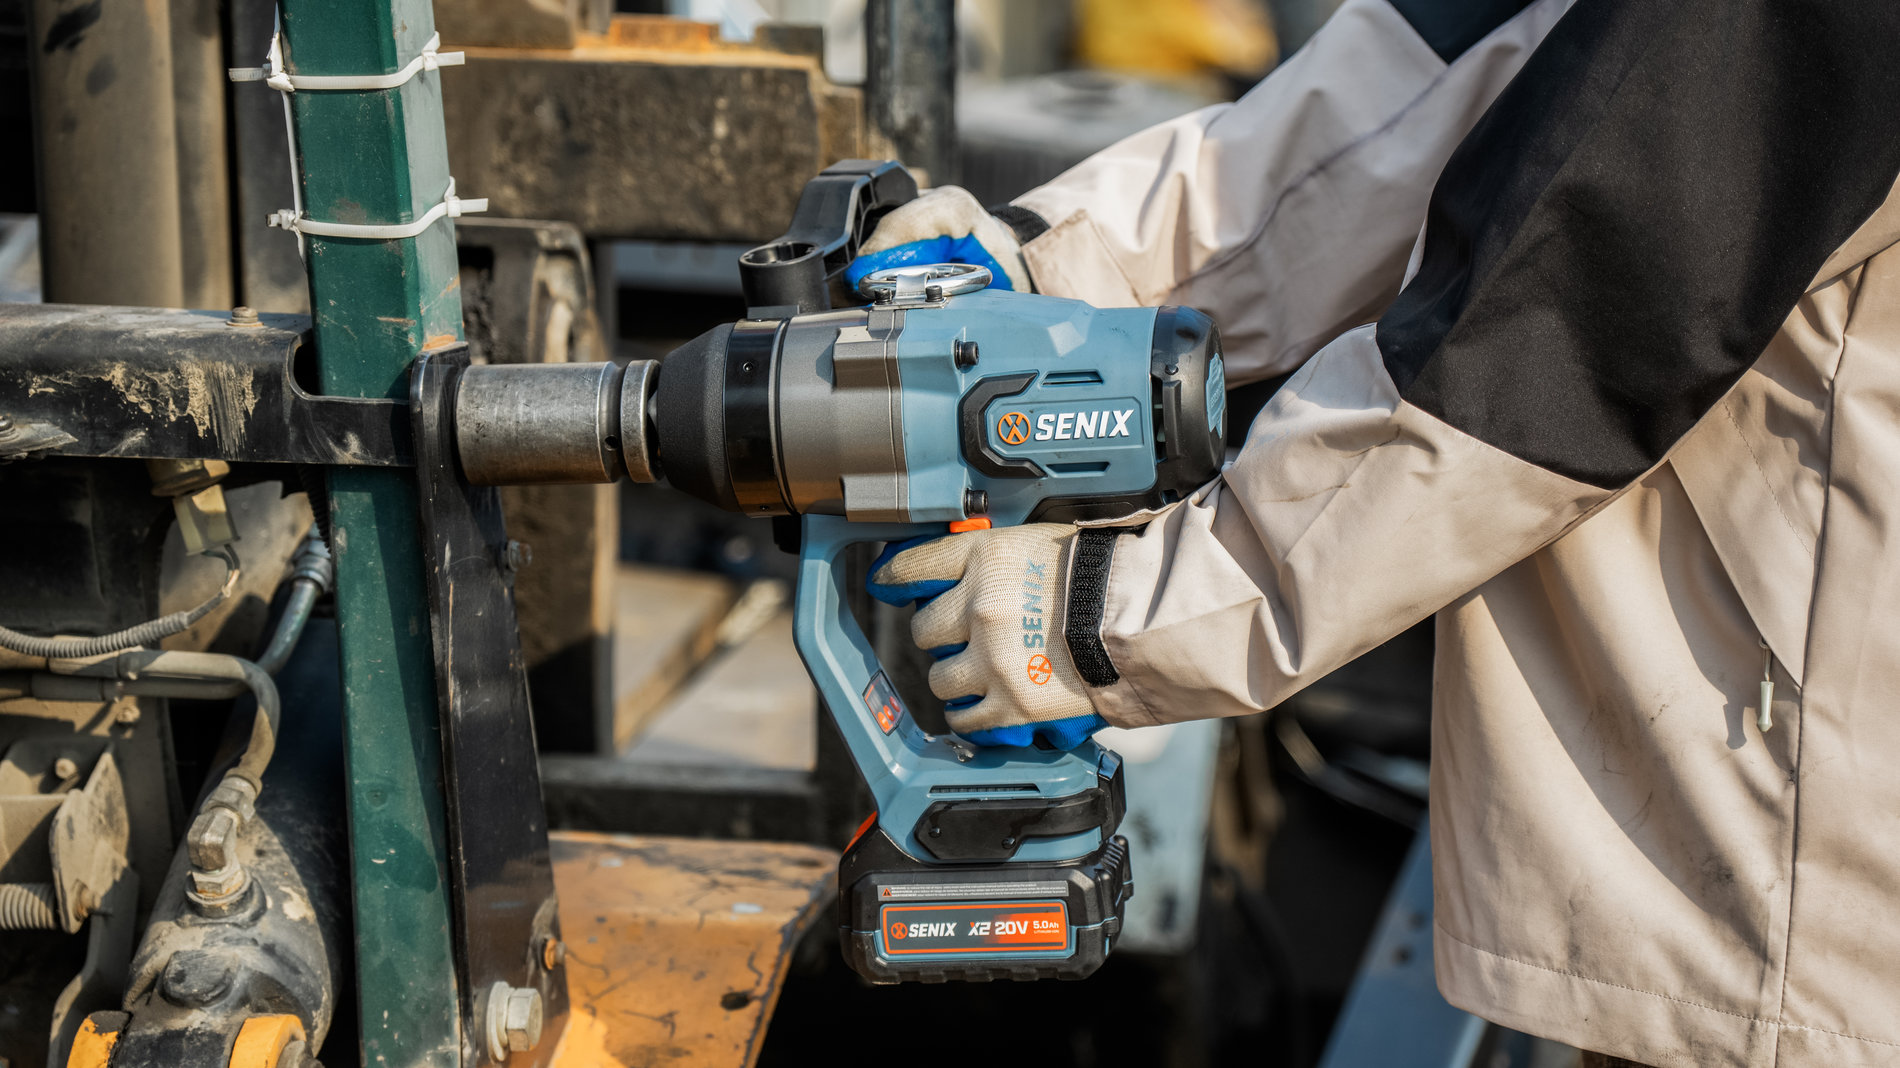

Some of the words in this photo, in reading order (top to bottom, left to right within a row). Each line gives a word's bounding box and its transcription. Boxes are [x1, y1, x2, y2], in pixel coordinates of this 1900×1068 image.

[1034, 409, 1135, 442] SENIX
[1022, 558, 1046, 648] SENIX
[908, 922, 957, 938] SENIX
[968, 921, 991, 936] X2
[995, 920, 1028, 935] 20V
